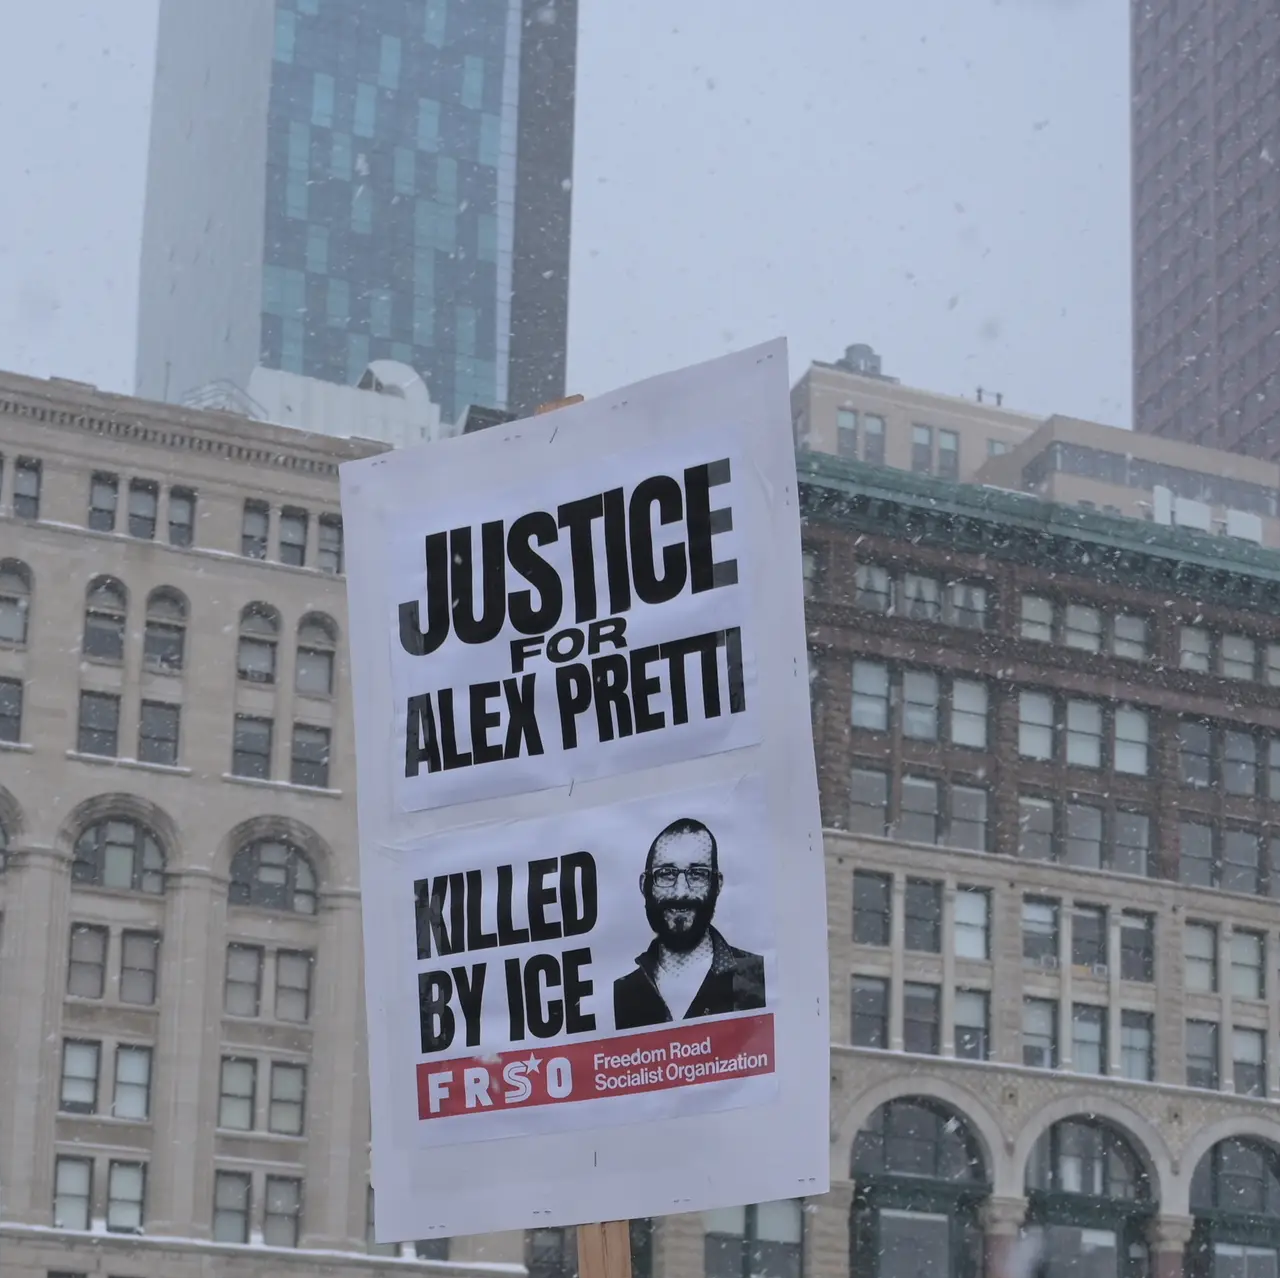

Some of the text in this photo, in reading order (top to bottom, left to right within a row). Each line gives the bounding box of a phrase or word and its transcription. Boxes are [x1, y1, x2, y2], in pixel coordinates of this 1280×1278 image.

[398, 457, 739, 656] JUSTICE
[509, 616, 627, 672] FOR
[405, 626, 746, 777] ALEX PRETTI
[413, 851, 598, 960] KILLED
[417, 946, 597, 1054] BY ICE
[427, 1056, 573, 1114] FRSO
[593, 1036, 711, 1071] Freedom Road
[594, 1051, 769, 1091] Socialist Organization
